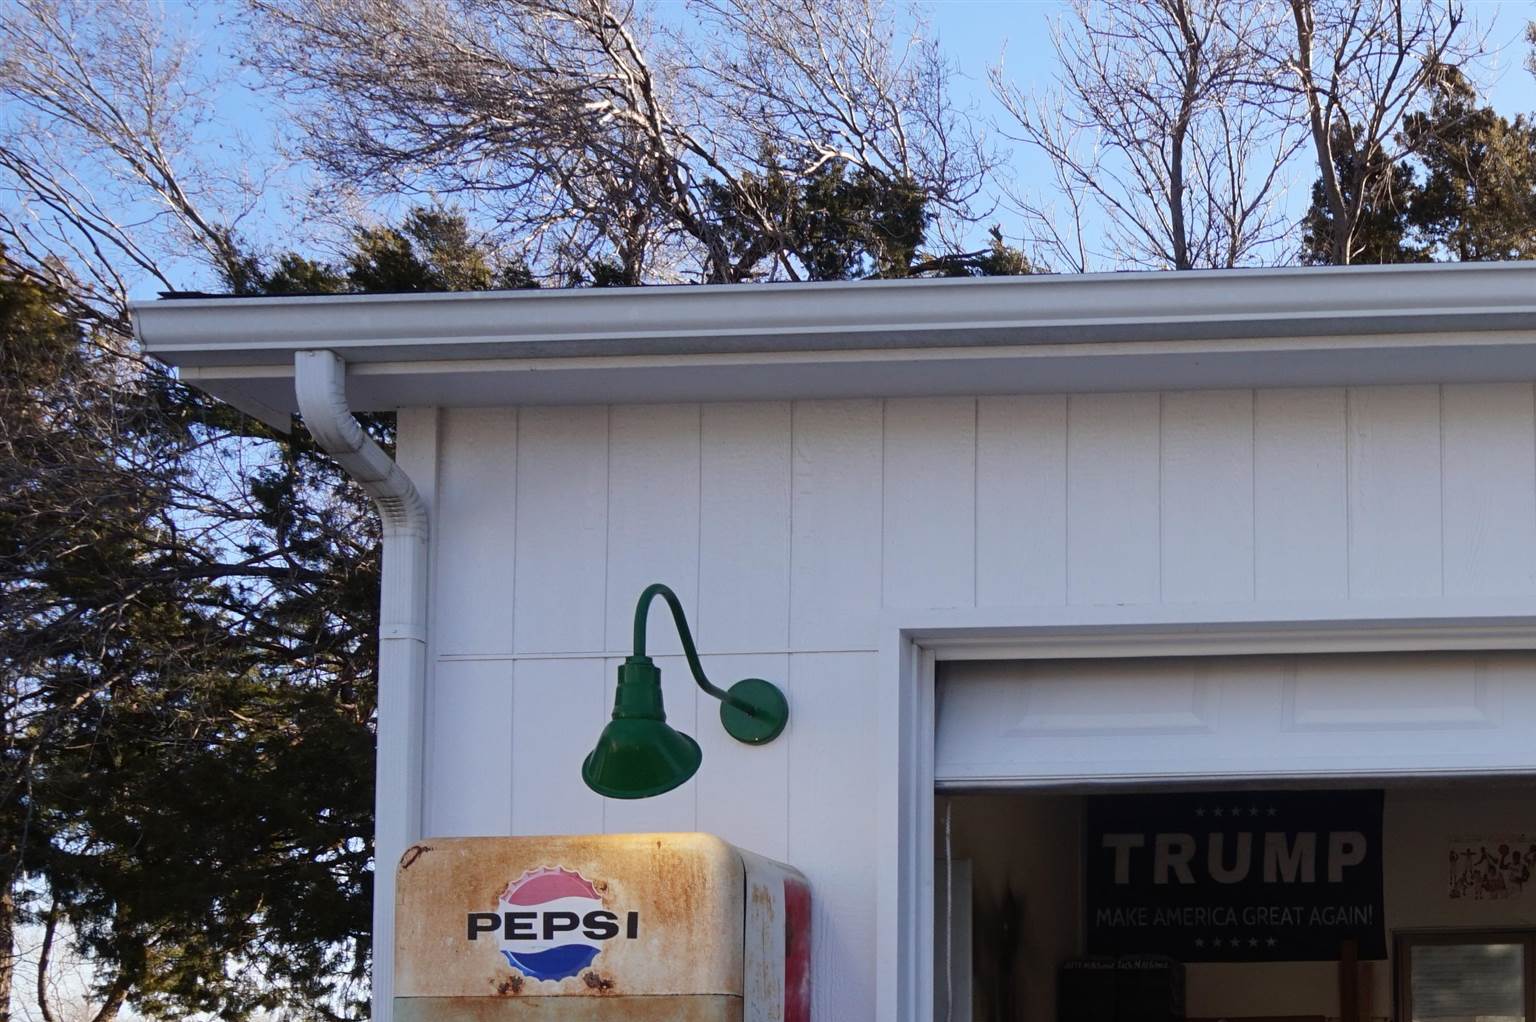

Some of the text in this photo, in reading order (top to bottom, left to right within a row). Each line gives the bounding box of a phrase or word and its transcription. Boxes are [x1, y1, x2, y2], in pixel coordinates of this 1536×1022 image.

[1102, 831, 1368, 884] TRUMP
[467, 911, 639, 940] PEPSI
[1096, 905, 1373, 927] MAKE AMERICA GREAT AGAIN!
